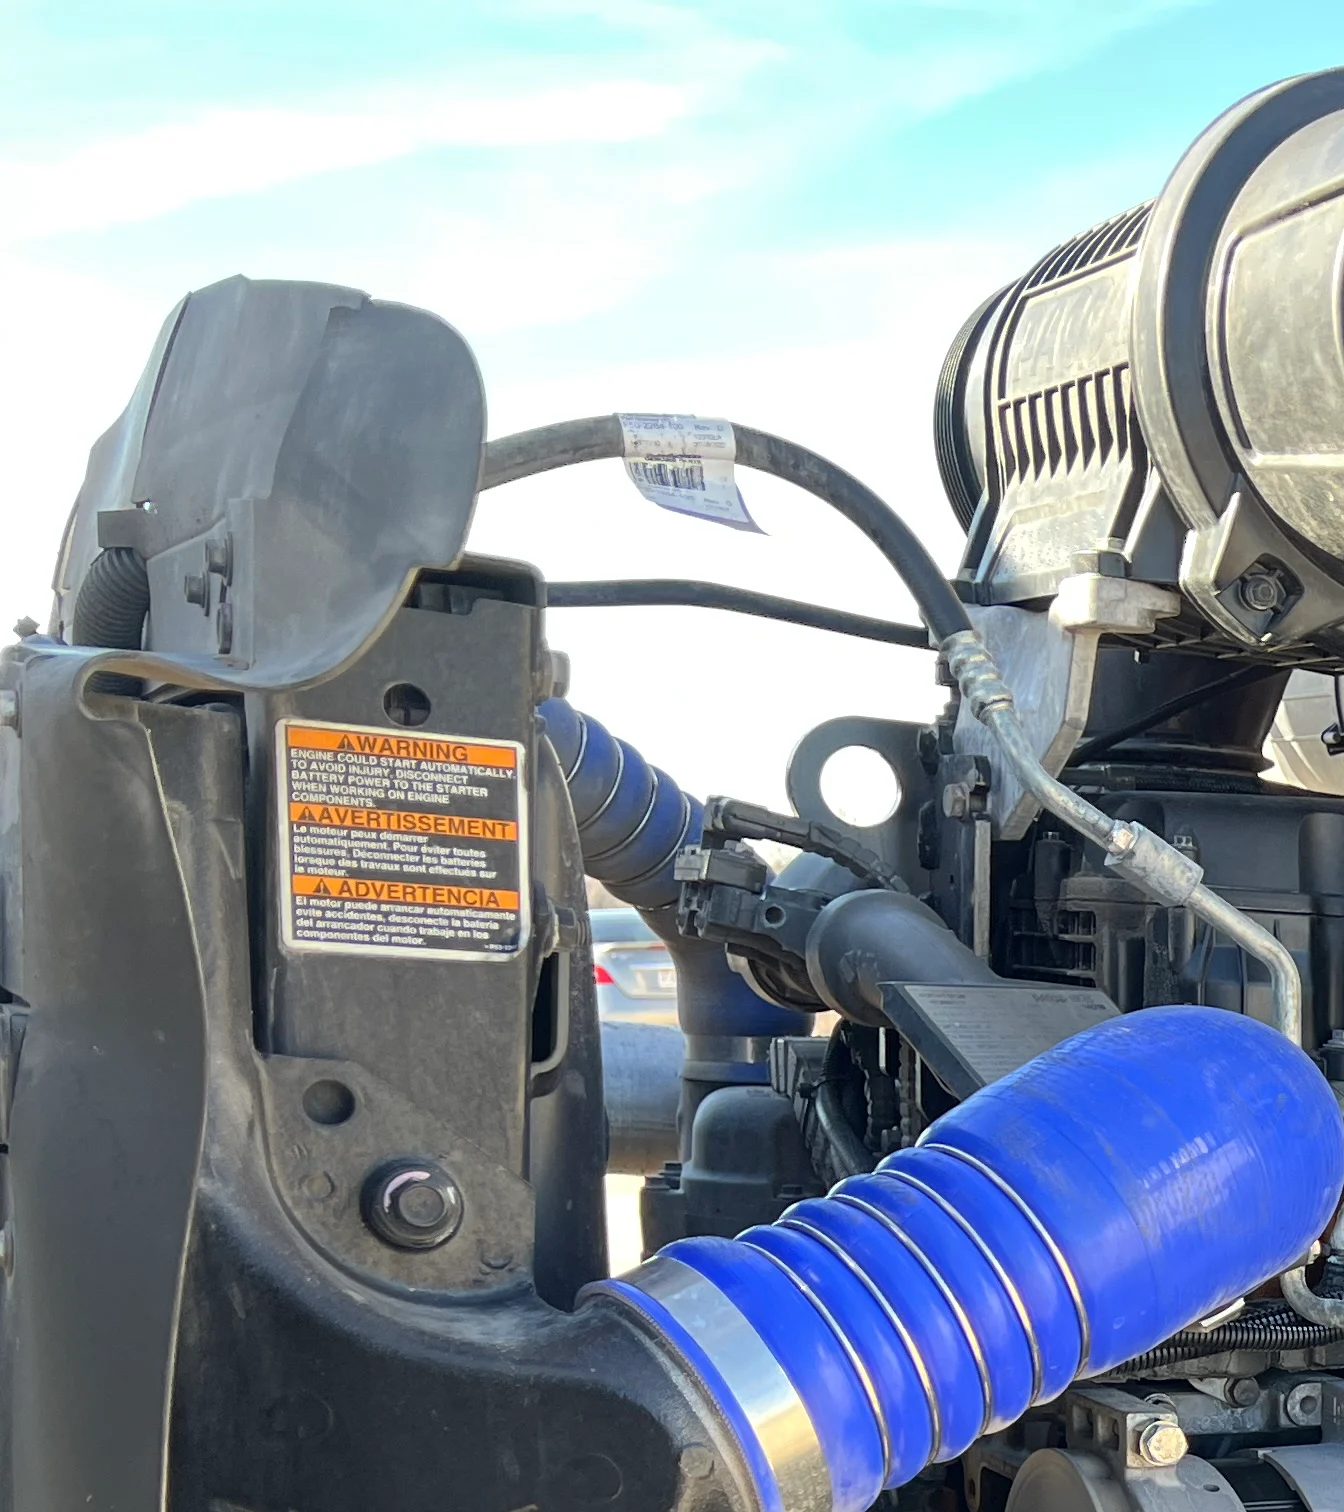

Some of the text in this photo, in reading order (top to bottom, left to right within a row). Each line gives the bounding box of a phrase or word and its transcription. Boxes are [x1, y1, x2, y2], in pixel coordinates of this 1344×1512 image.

[357, 736, 468, 761] WARNING
[291, 748, 516, 779] ENGINE COULD START AUTOMATICALLY.
[291, 760, 468, 784] TO AVOID INJURY. DISCONNECT
[292, 770, 488, 797] BATTERY POWER TO THE STARTER
[292, 781, 449, 804] WHEN WORKING ON ENGINE
[292, 792, 376, 808] COMPONENTS.
[294, 824, 306, 833] Le
[310, 826, 348, 836] moteur
[351, 830, 377, 839] peux
[319, 806, 510, 838] AVERTISSEMENT
[393, 842, 418, 852] Pour
[453, 848, 486, 858] toutes
[294, 854, 335, 866] lorsque
[361, 860, 400, 870] travaux
[403, 865, 427, 873] sont
[296, 896, 307, 906] El
[310, 899, 342, 907] motor
[344, 901, 377, 911] puede
[338, 880, 500, 907] ADVERTENCIA
[296, 908, 322, 917] evite
[388, 915, 449, 926] desconecte
[296, 918, 313, 927] del
[316, 920, 375, 931] arrancador
[377, 924, 416, 933] cuando
[473, 930, 490, 939] los
[296, 930, 370, 941] componentes
[372, 934, 389, 942] del
